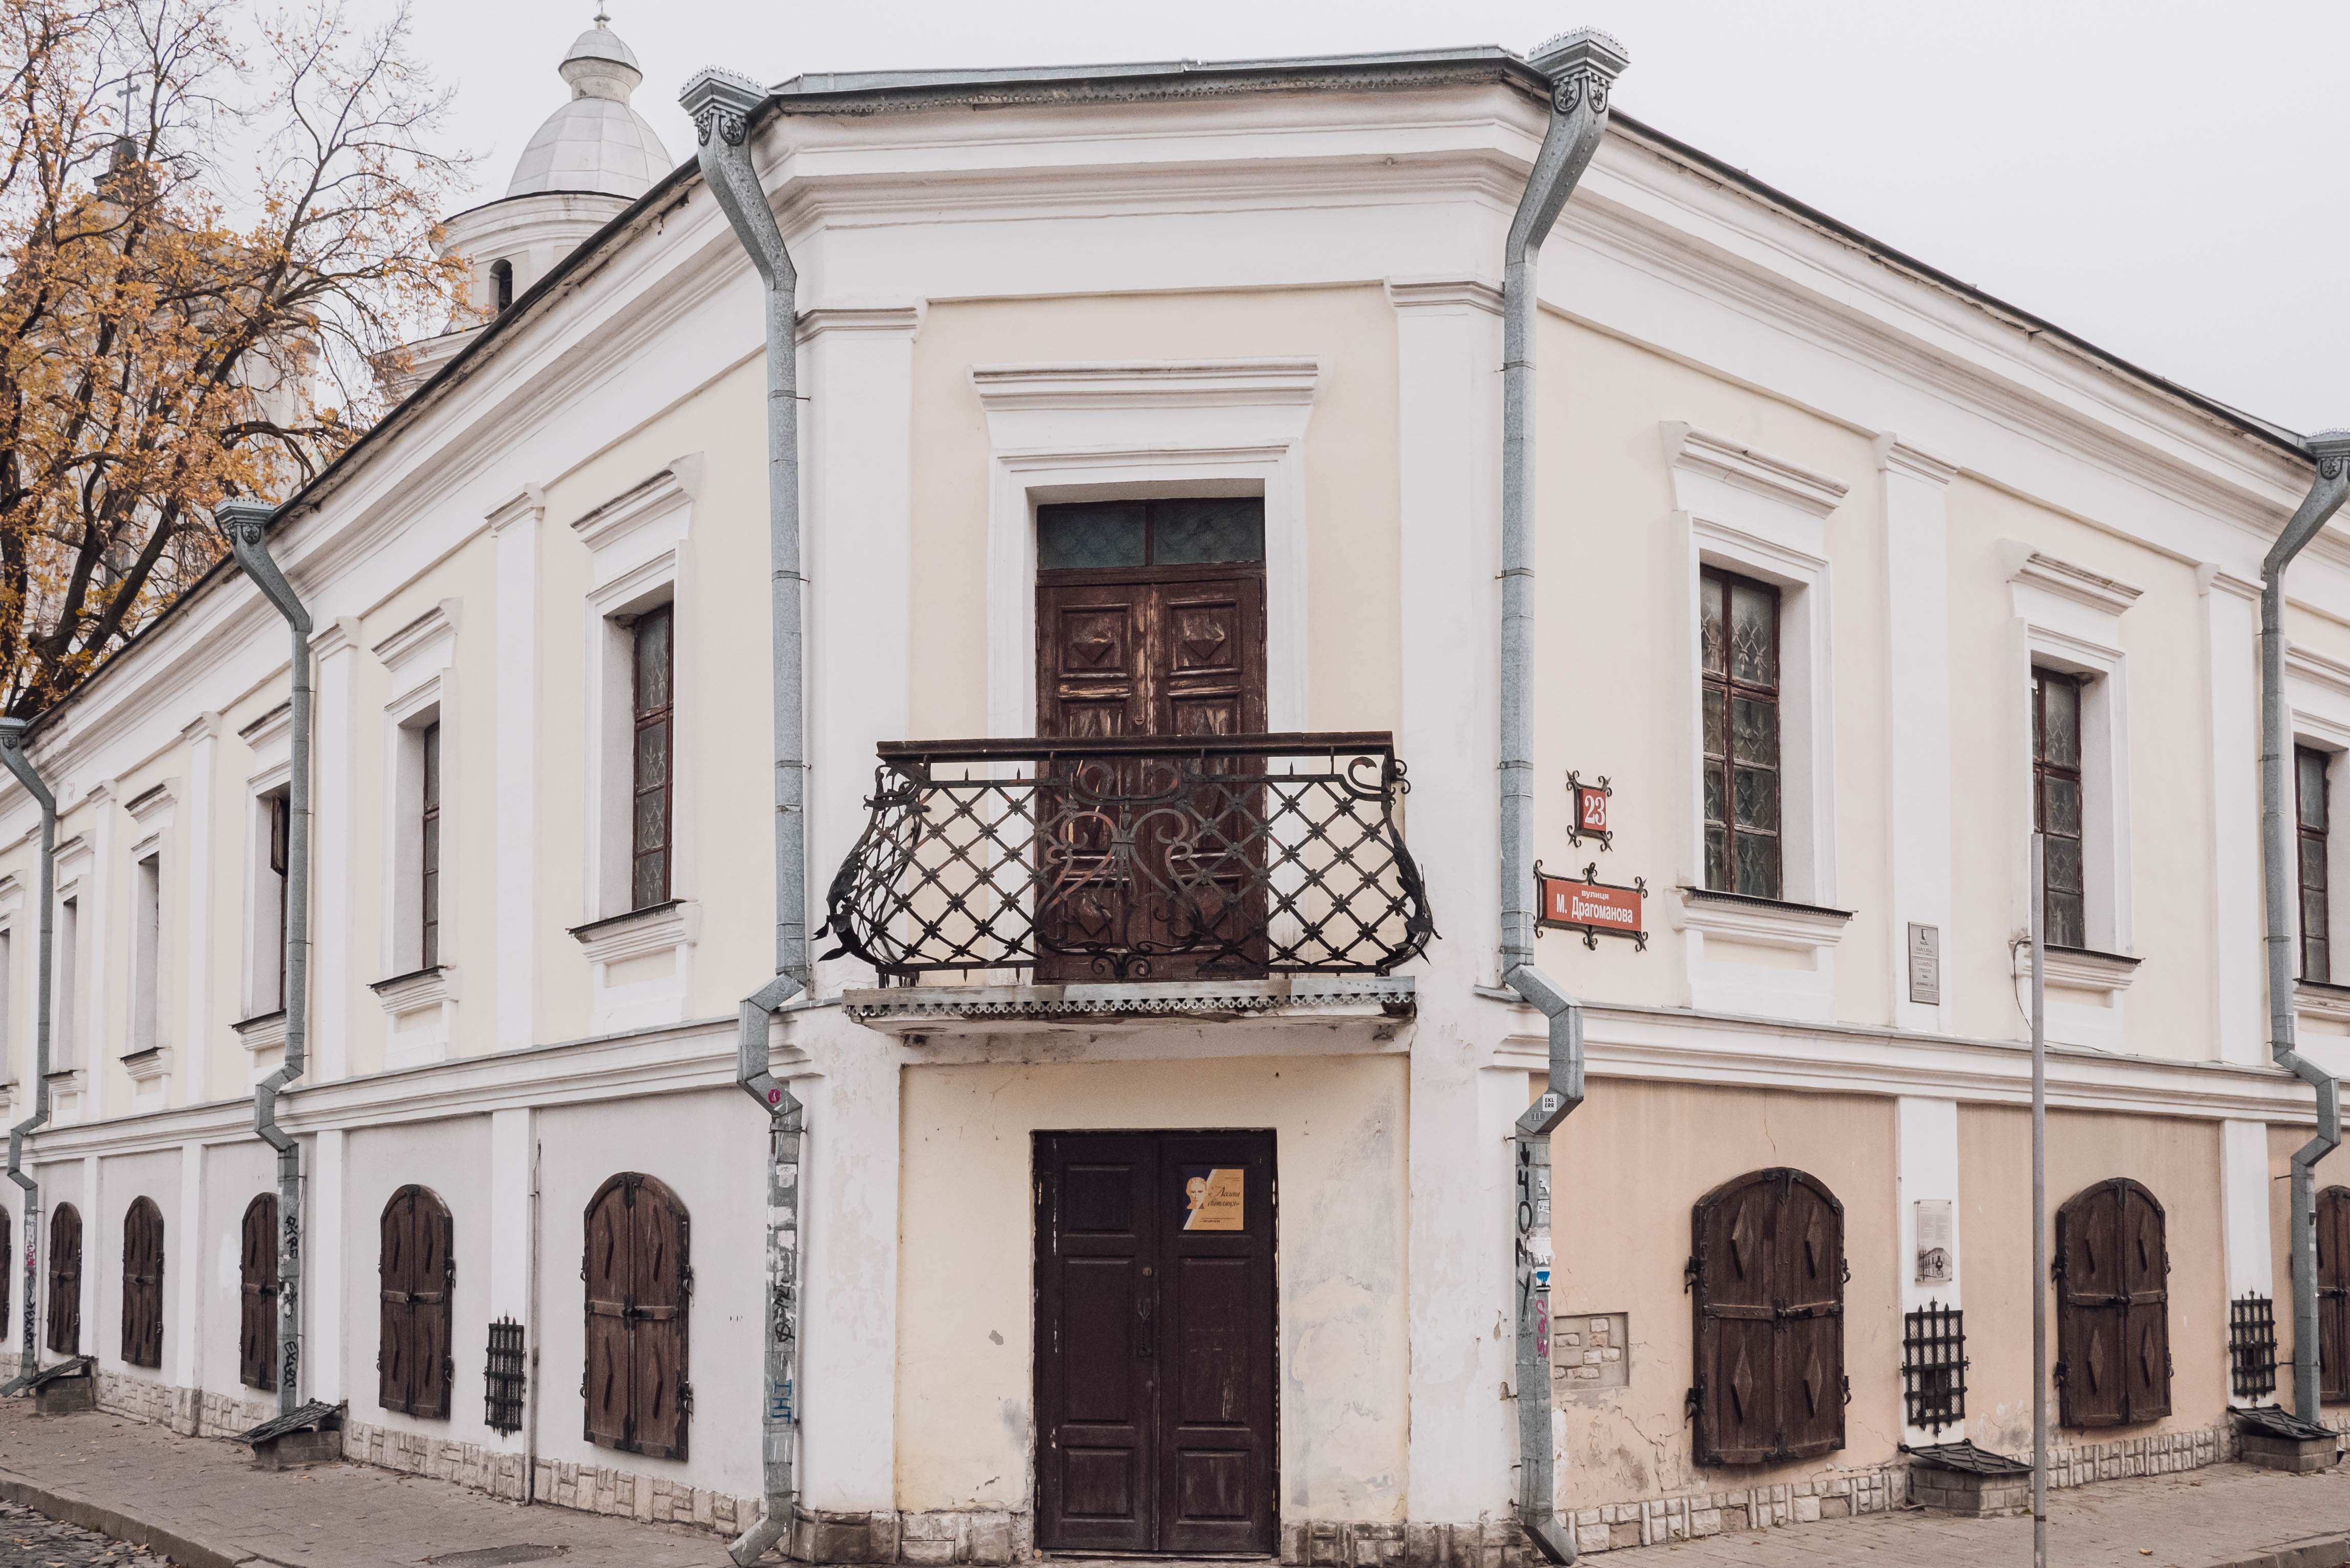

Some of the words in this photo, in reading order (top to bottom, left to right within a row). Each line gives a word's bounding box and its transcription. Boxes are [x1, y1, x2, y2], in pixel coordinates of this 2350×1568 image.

[1585, 795, 1605, 825] 23
[1556, 893, 1568, 913] М.
[1572, 896, 1633, 923] Драгоманова
[1581, 890, 1609, 900] вулиця
